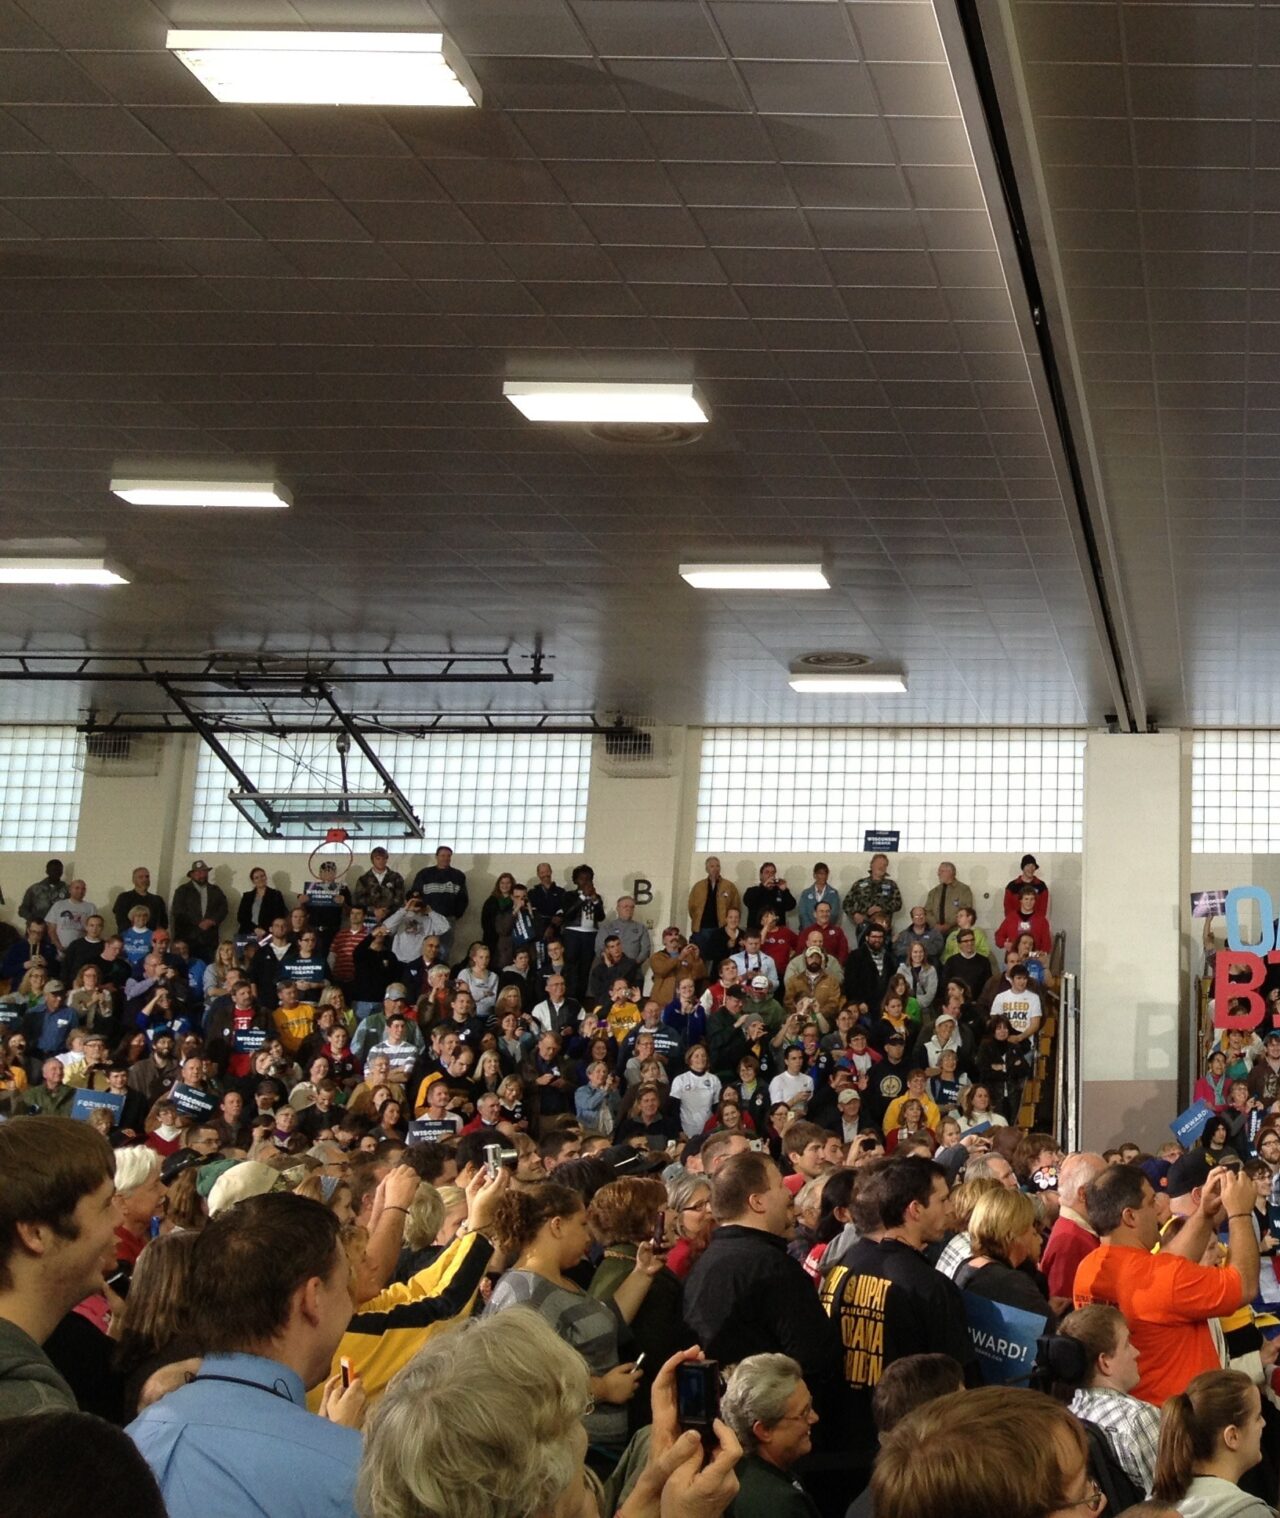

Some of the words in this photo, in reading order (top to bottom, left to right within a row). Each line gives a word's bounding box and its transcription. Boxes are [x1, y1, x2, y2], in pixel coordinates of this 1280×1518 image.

[633, 878, 653, 905] B
[1002, 1001, 1030, 1011] BLEED
[1007, 1011, 1028, 1020] LACK
[1013, 1020, 1027, 1028] OLD
[76, 1098, 119, 1111] FORWARD!
[173, 1090, 213, 1111] WISCONSIN
[1177, 1109, 1209, 1137] FORWARD!
[854, 1273, 893, 1312] IUPAT
[967, 1325, 1028, 1363] WARD!
